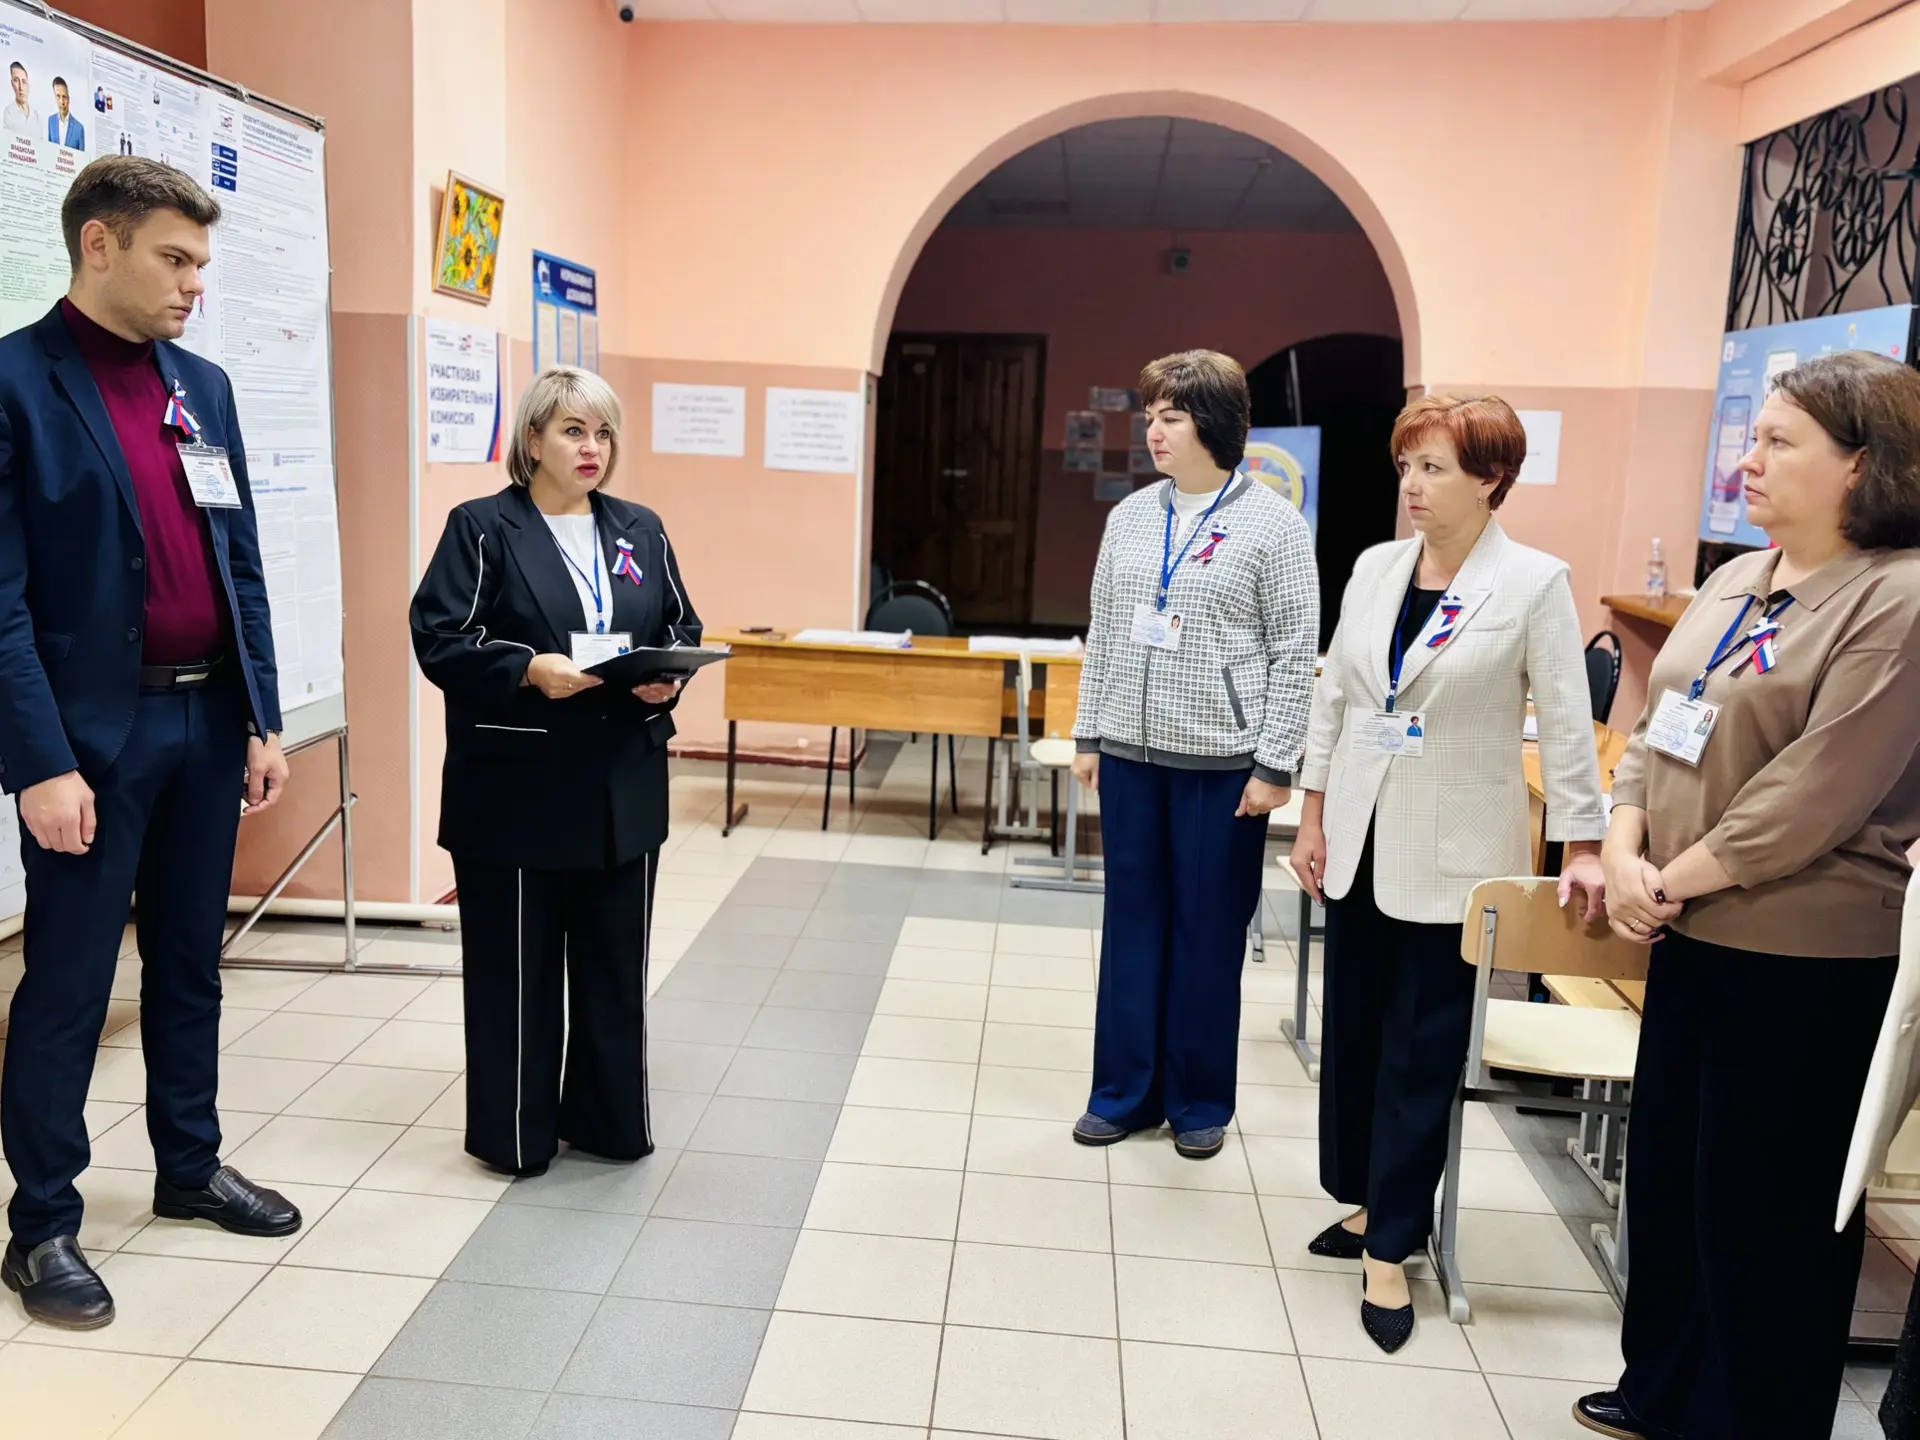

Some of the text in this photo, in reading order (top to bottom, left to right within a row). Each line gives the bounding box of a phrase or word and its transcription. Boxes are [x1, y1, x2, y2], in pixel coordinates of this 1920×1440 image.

[429, 363, 481, 382] УЧАСТКОВАЯ
[429, 386, 493, 405] ИЗБИРАТЕЛЬНАЯ
[430, 409, 475, 425] КОМИССИЯ
